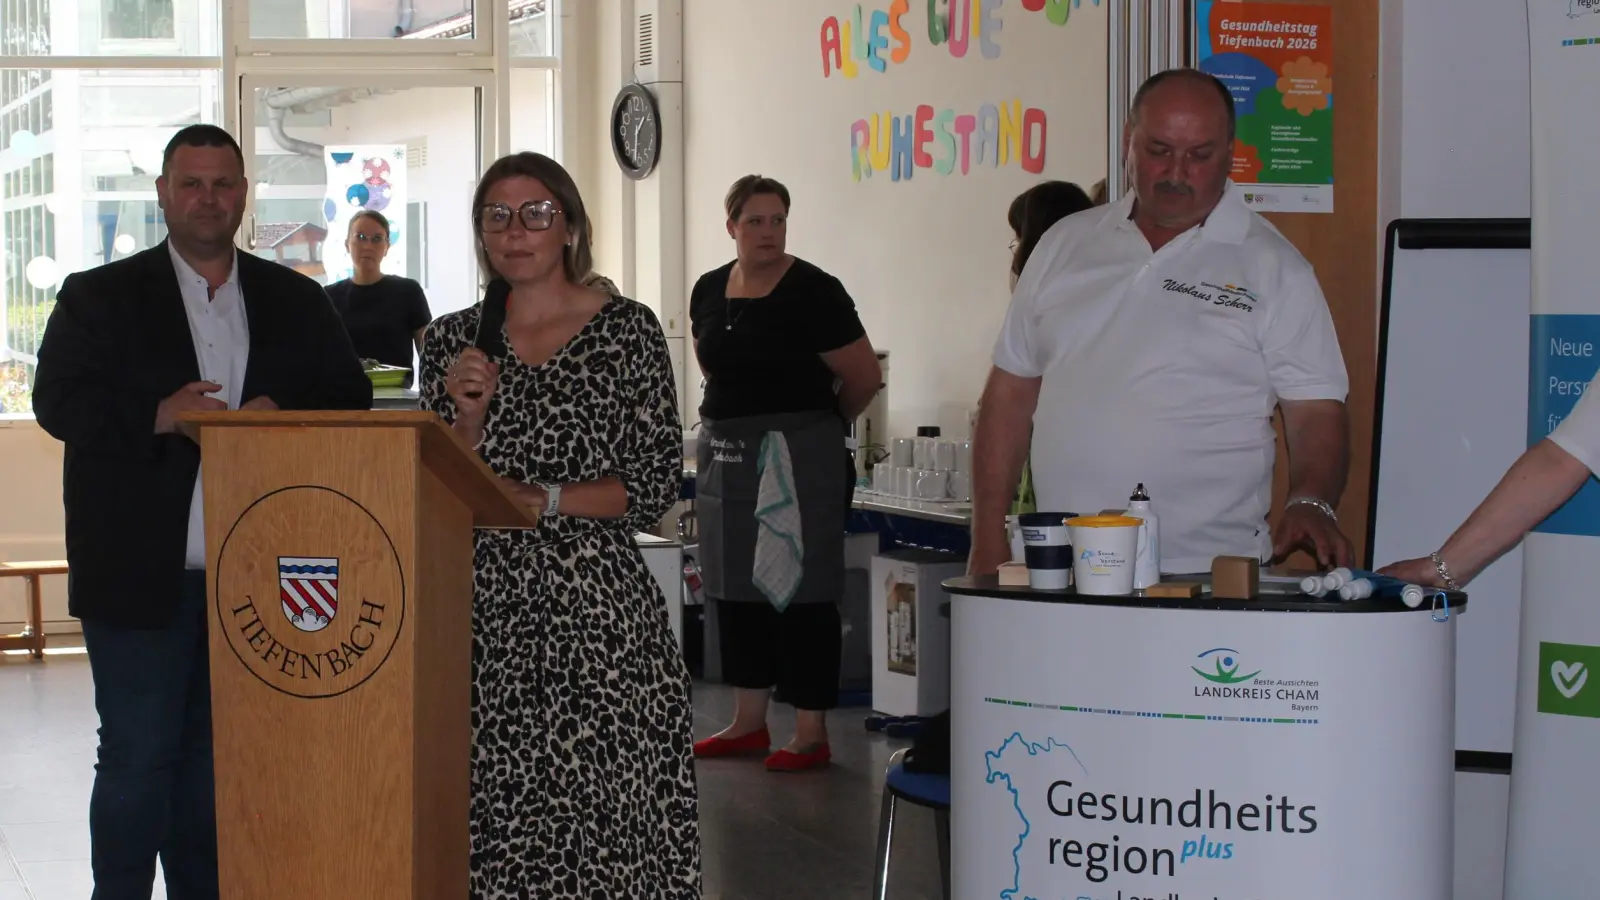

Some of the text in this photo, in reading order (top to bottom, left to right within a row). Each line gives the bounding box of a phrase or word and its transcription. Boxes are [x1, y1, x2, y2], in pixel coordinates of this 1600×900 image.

[820, 0, 911, 79] ALLES
[1220, 19, 1318, 37] Gesundheitstag
[1219, 34, 1317, 50] Tiefenbach 2026
[851, 98, 1047, 182] RUHESTAND
[1162, 279, 1211, 301] Nikolaus
[1213, 294, 1253, 312] Scherr
[1550, 337, 1593, 356] Neue
[232, 595, 385, 679] TIEFENBACH
[1194, 686, 1319, 700] LANDKREIS CHAM
[1253, 678, 1319, 687] Beste Aussichten
[1291, 703, 1319, 711] Bayern
[1046, 780, 1318, 834] Gesundheits
[1049, 834, 1234, 882] region plus
